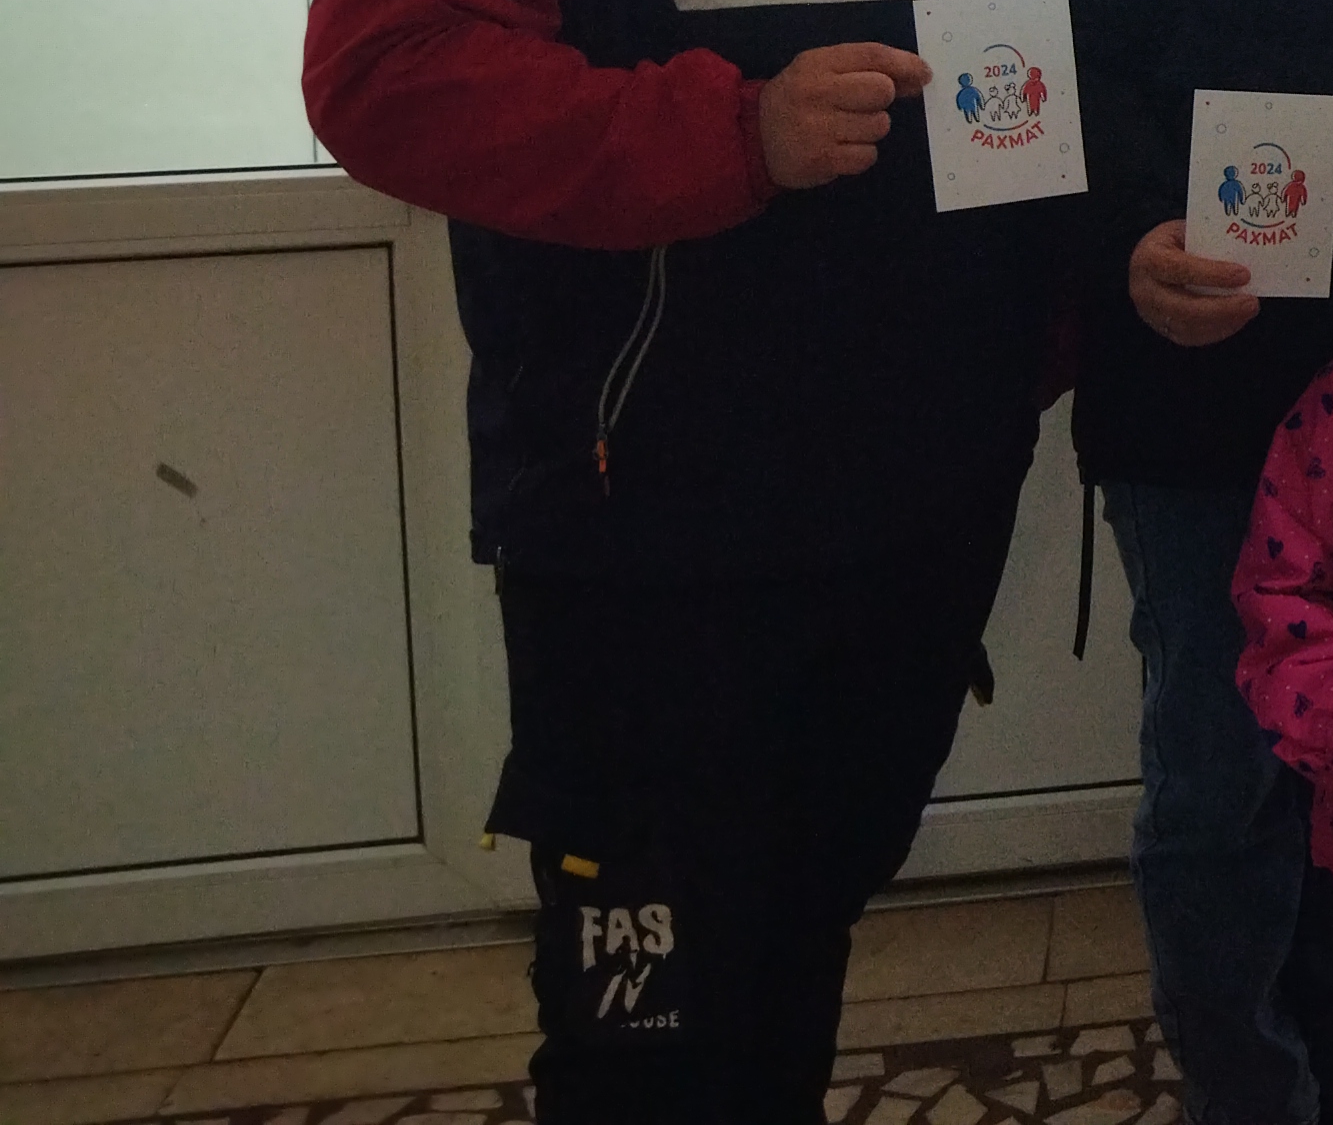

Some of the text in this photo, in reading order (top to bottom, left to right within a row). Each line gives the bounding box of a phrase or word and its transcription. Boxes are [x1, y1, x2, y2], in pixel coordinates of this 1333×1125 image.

[984, 63, 1018, 79] 2024
[970, 120, 1046, 151] РАХМАТ
[1250, 162, 1282, 175] 2024
[1226, 221, 1300, 246] РАХМАТ
